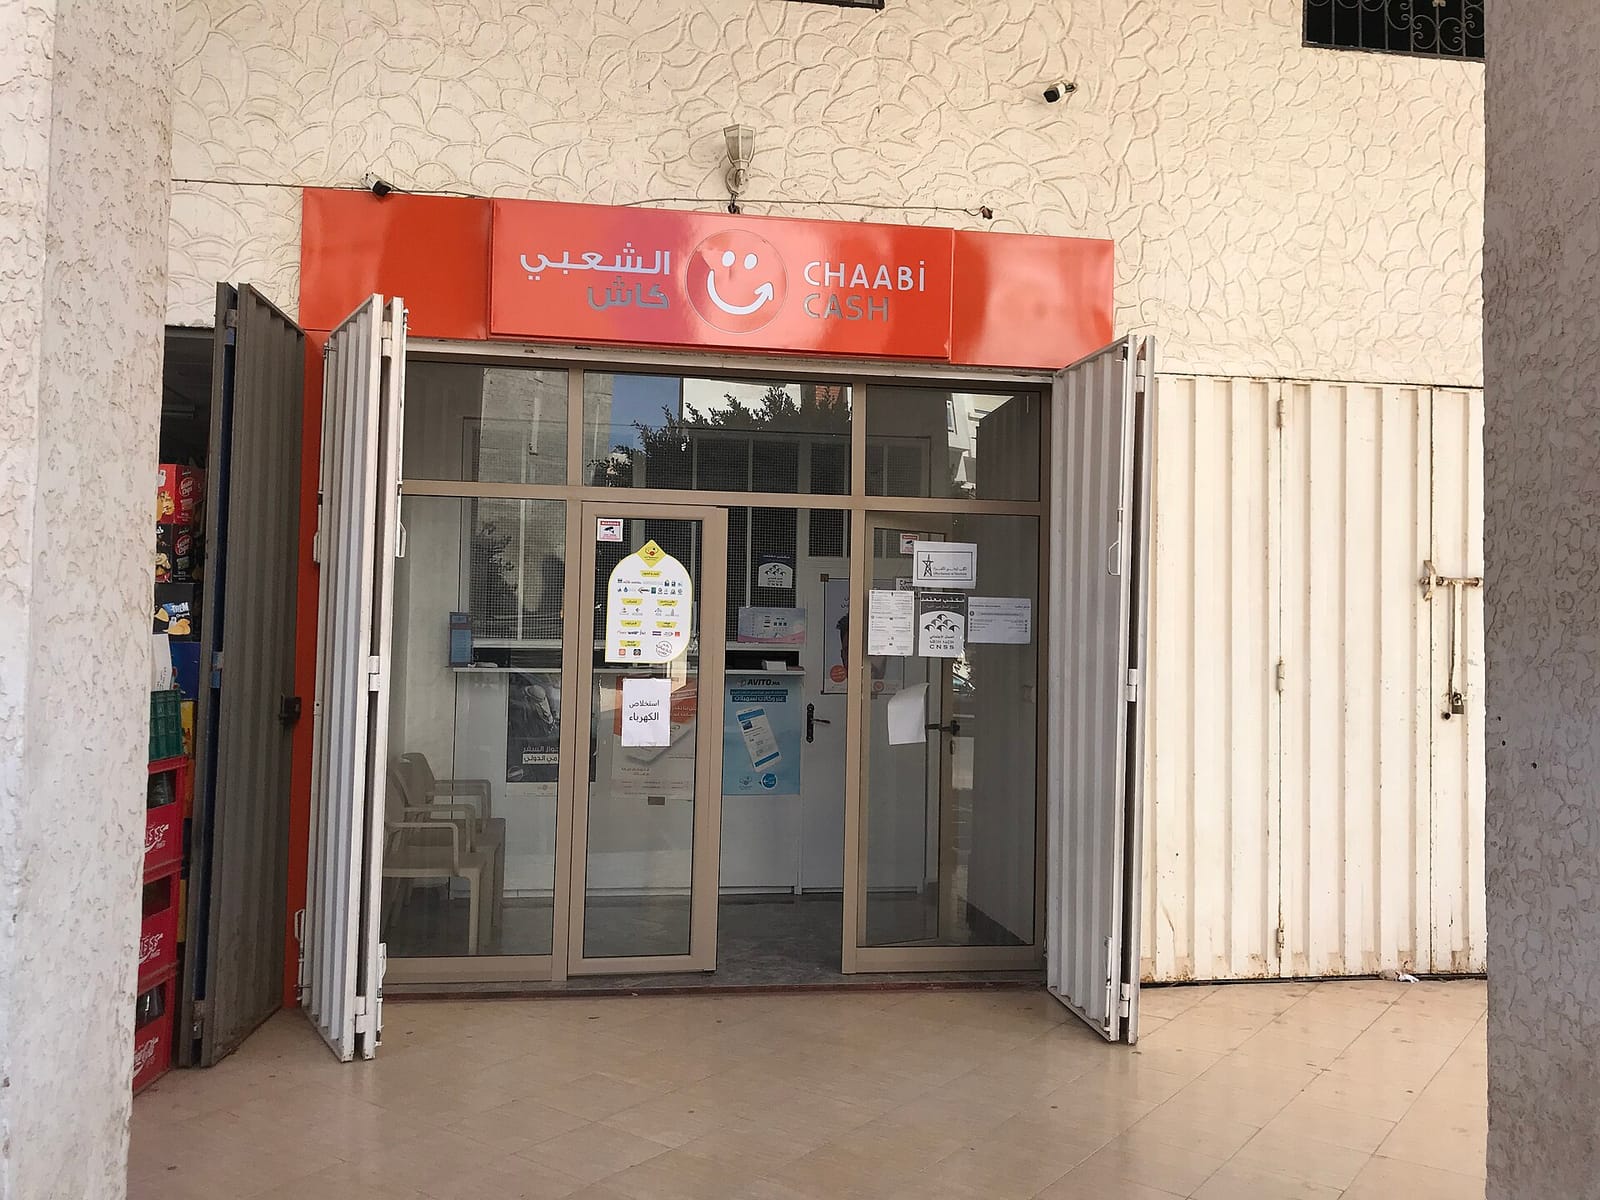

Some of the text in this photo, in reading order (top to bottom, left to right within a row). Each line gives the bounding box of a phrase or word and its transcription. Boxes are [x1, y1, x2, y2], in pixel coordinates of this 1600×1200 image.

[519, 242, 671, 281] الشعبي
[587, 276, 670, 311] كاش
[803, 293, 890, 322] CASH
[628, 699, 660, 709] استخلاص
[628, 711, 660, 723] الكهرباء
